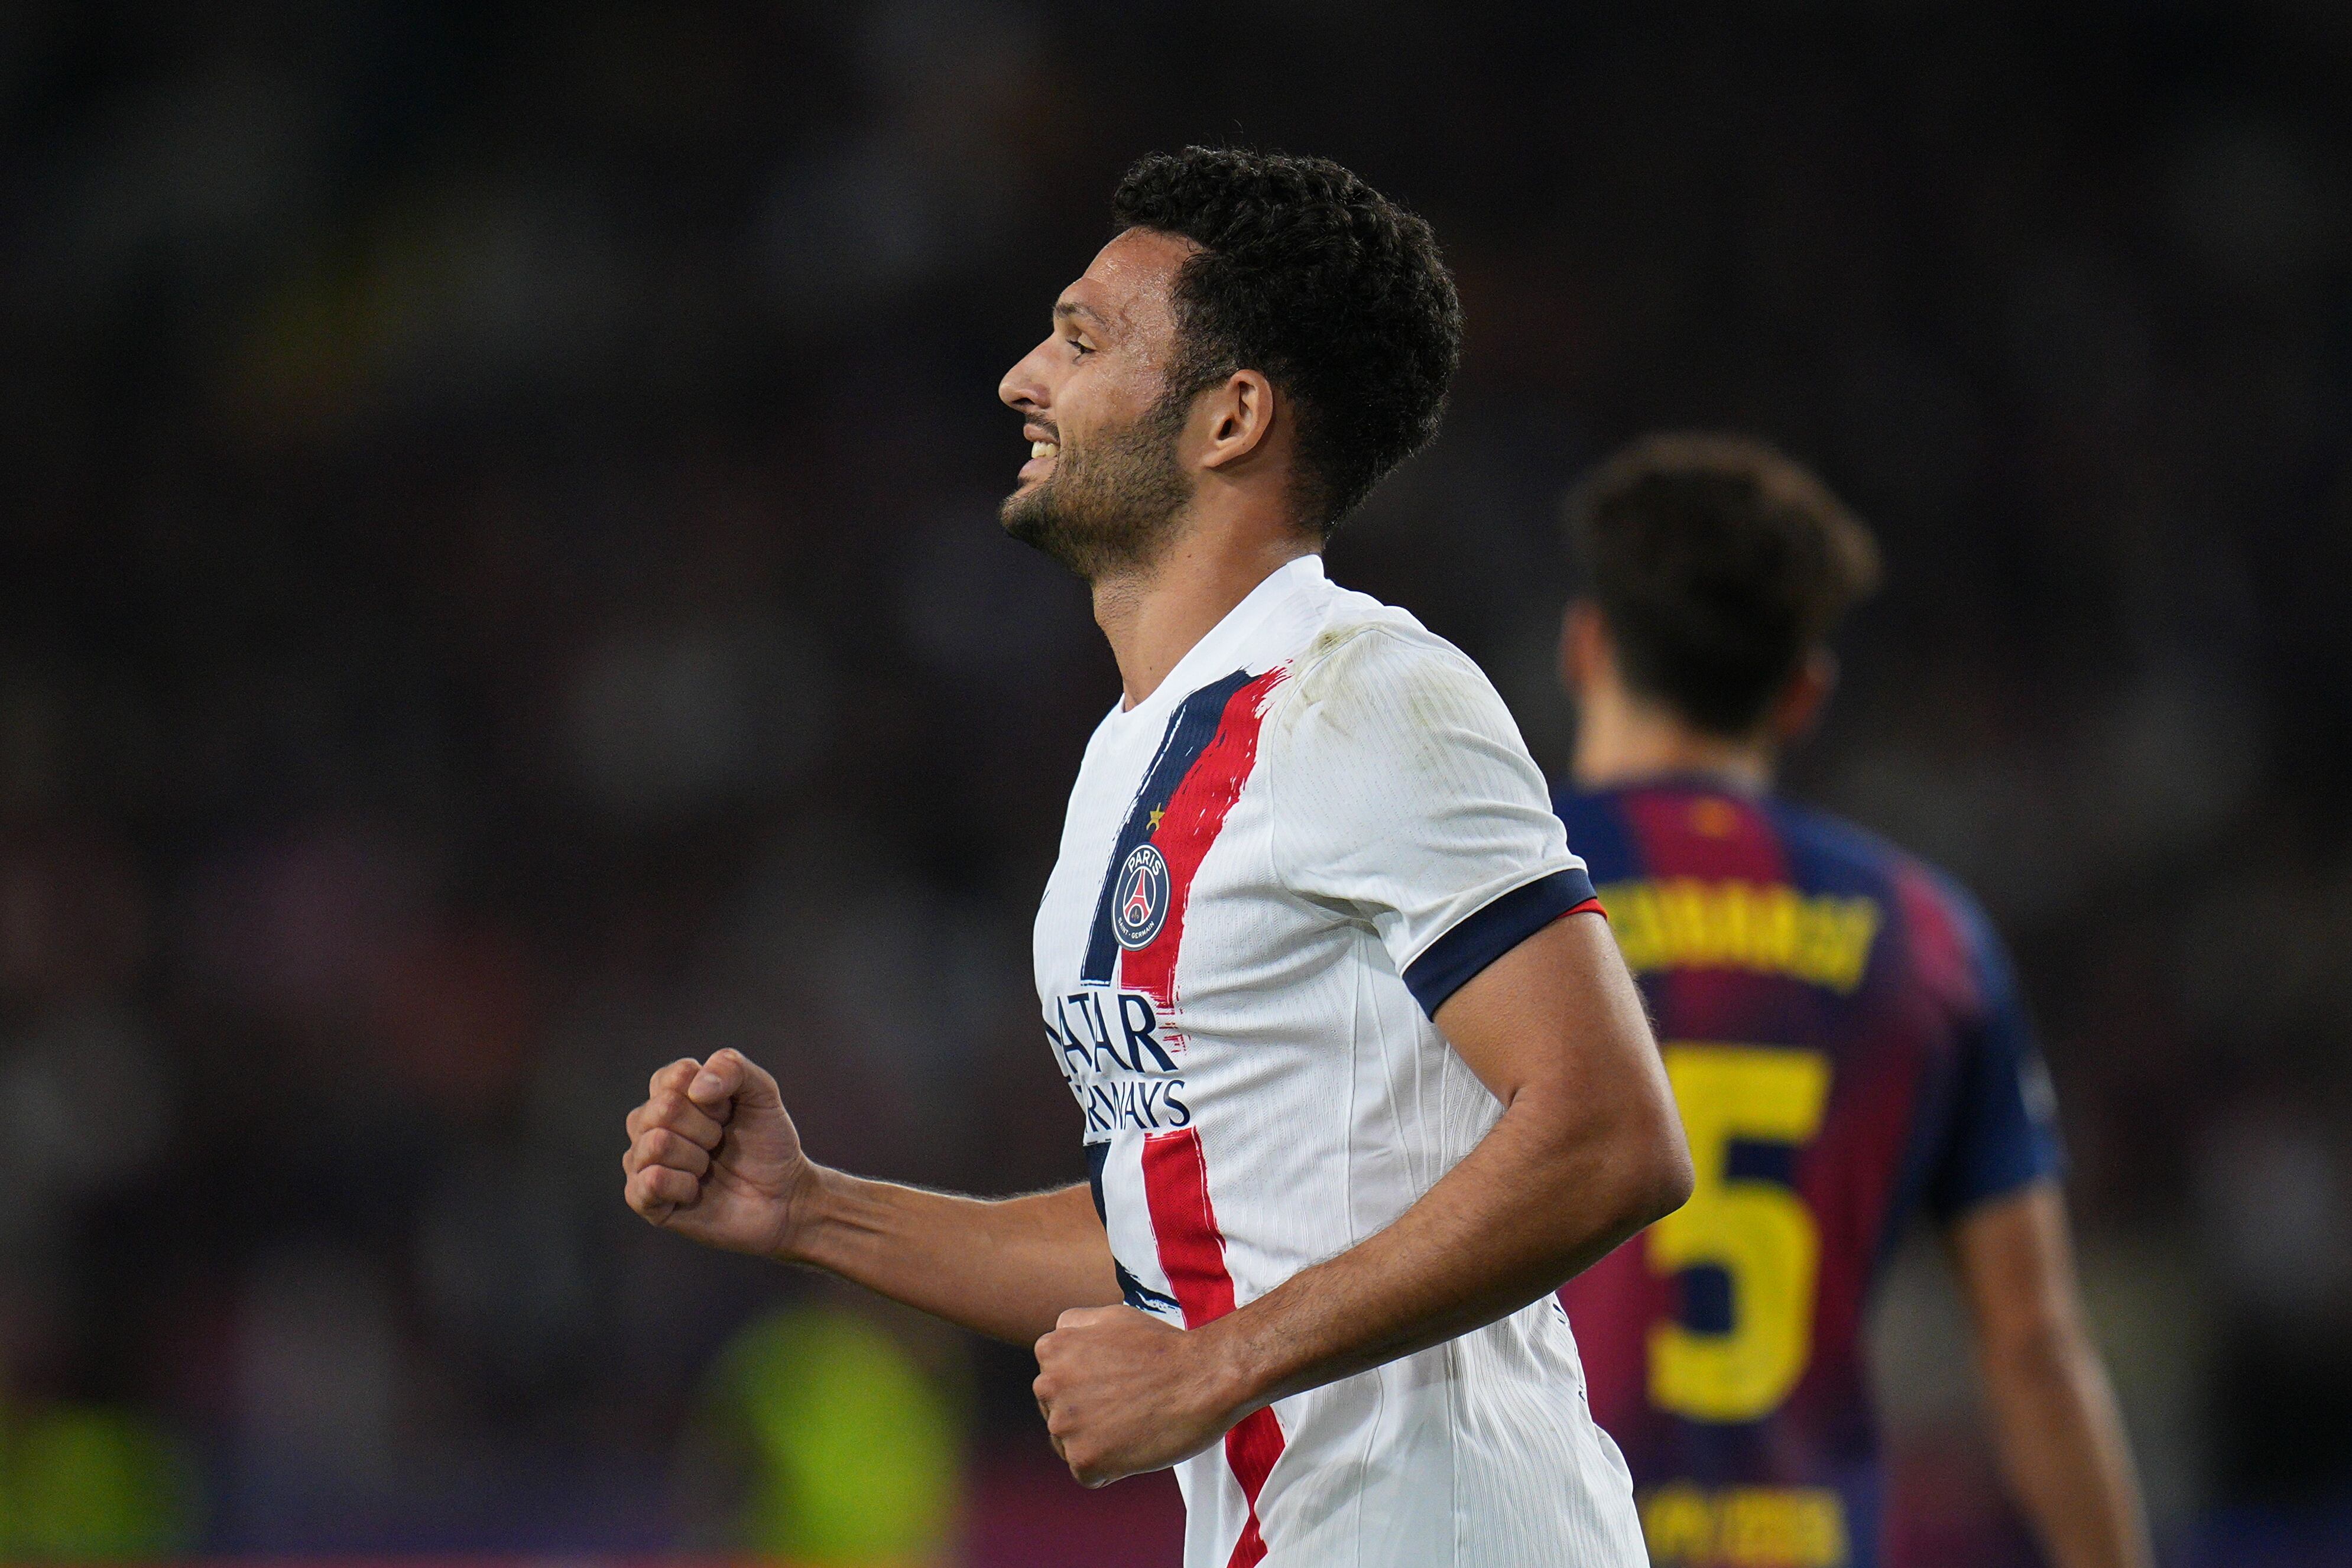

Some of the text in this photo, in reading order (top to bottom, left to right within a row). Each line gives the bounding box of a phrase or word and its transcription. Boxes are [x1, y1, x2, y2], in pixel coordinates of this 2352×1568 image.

[1128, 850, 1162, 876] PARIS
[1118, 917, 1154, 939] SAINT GERMAIN
[1065, 1075, 1190, 1132] RWAYS
[1648, 1041, 1829, 1423] 5
